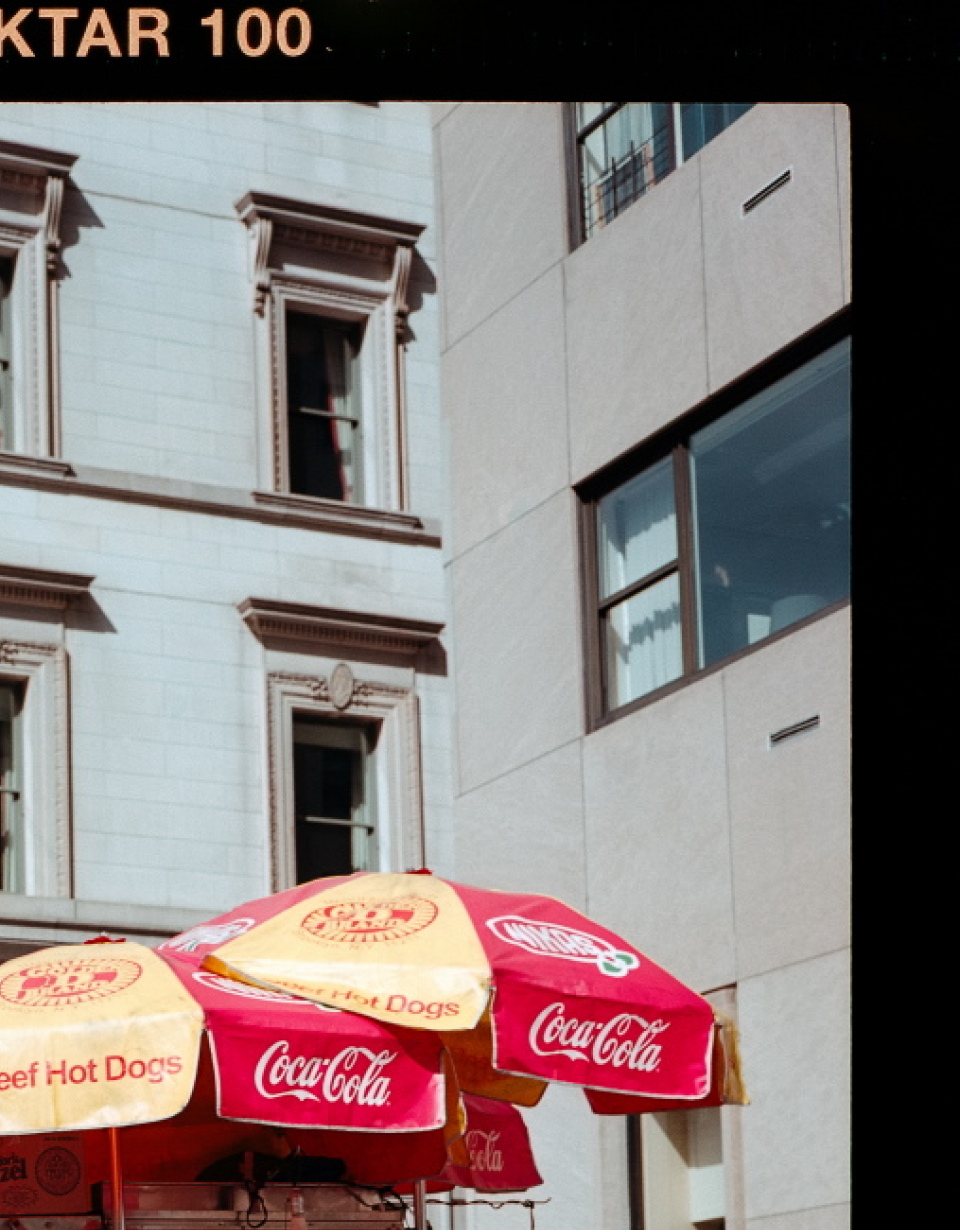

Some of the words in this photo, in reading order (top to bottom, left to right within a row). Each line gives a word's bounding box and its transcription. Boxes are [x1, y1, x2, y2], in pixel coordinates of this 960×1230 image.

[386, 994, 460, 1020] Dogs
[529, 1001, 671, 1073] Coca-Cola
[46, 1059, 98, 1085] Hot
[105, 1055, 183, 1084] Dogs
[254, 1040, 398, 1107] Coca-Cola
